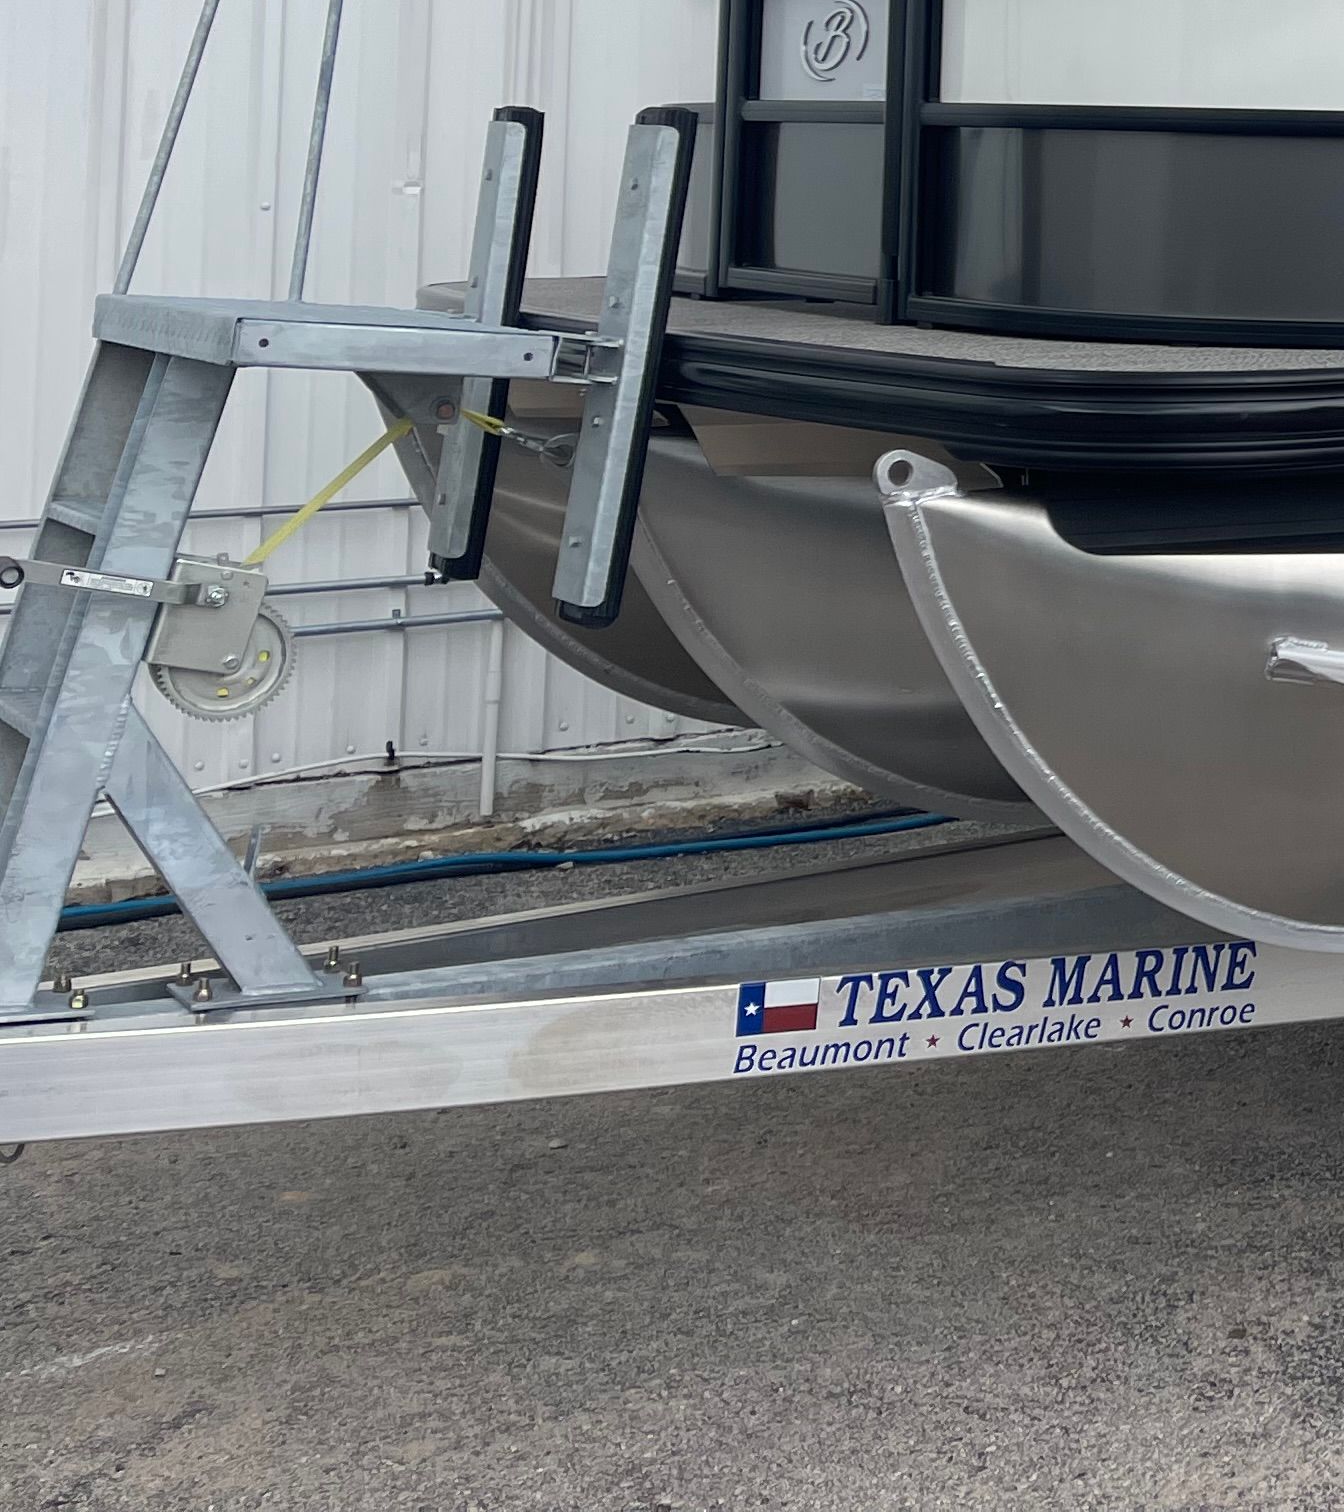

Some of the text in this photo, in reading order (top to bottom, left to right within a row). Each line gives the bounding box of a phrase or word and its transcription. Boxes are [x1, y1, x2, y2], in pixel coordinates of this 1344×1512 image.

[836, 941, 1258, 1027] TEXAS MARINE
[733, 1000, 1256, 1074] Beaumont Clearlake Conroe
